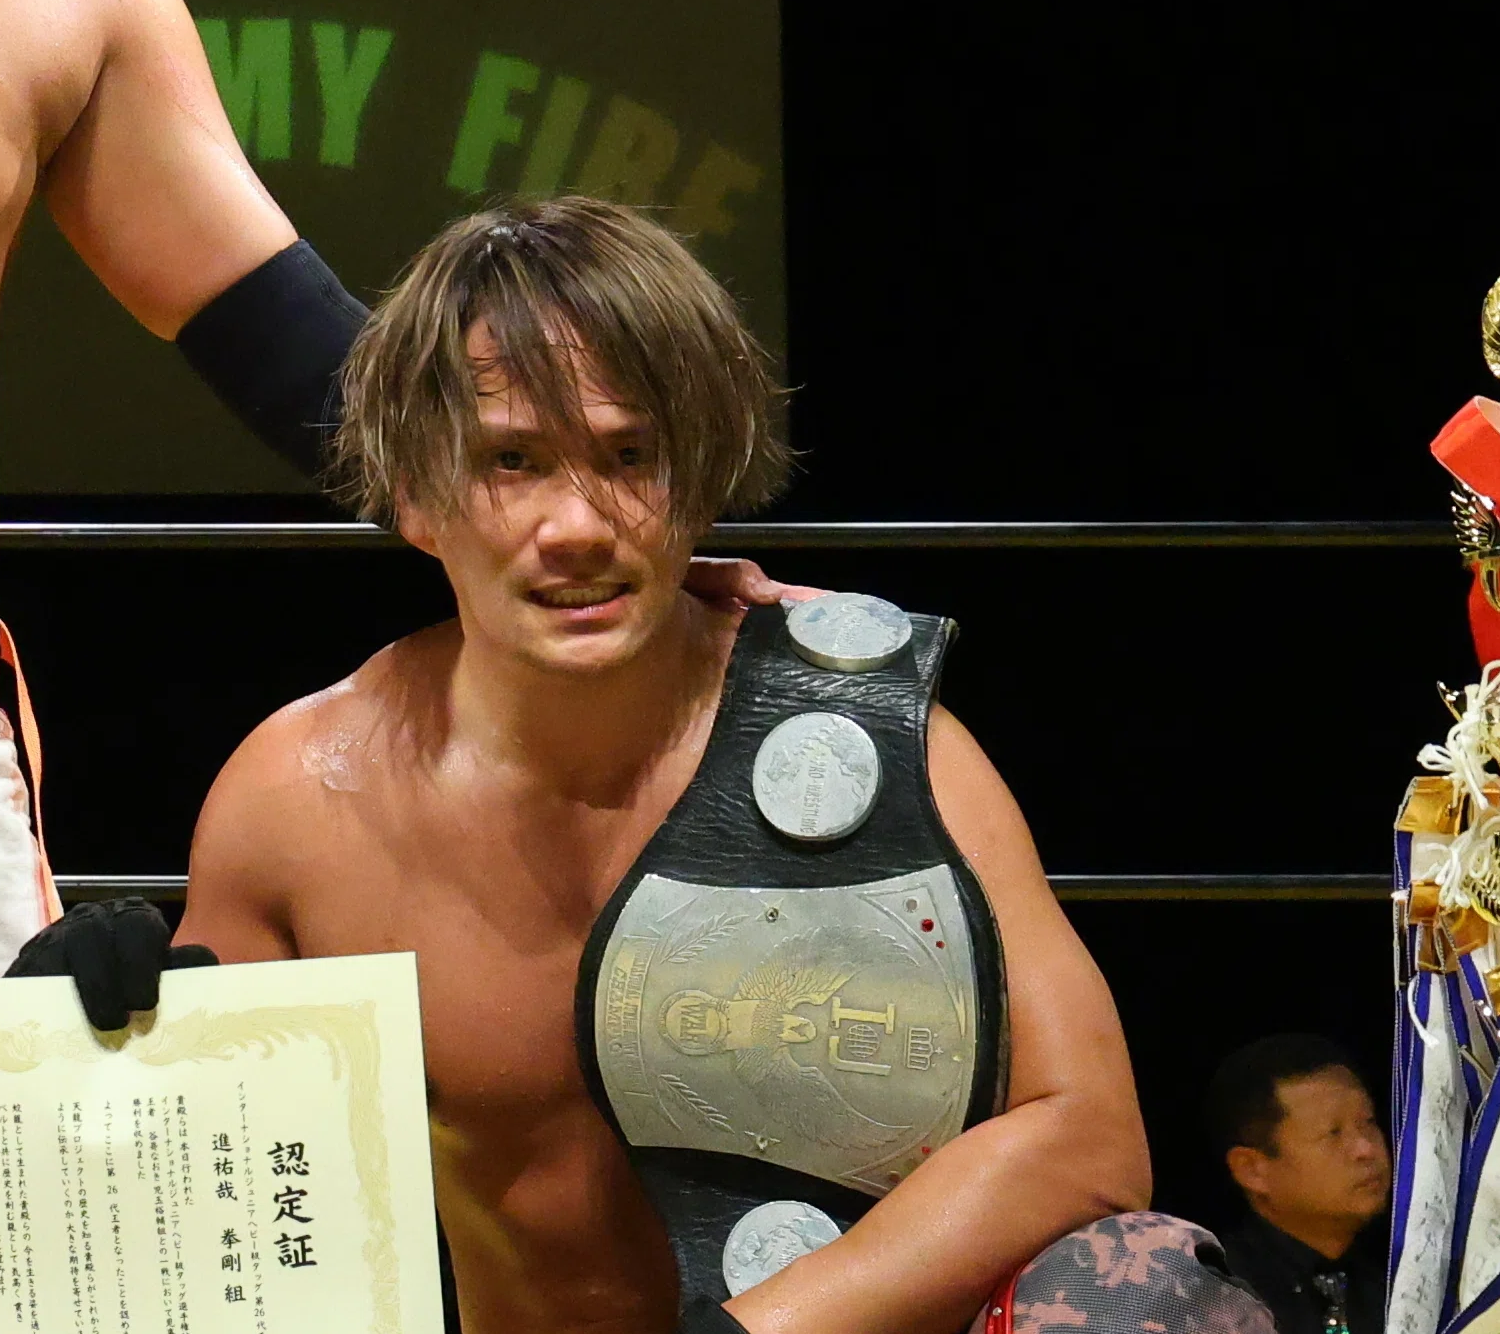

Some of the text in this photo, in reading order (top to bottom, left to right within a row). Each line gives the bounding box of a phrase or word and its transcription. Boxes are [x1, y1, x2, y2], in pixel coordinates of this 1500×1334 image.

[195, 17, 395, 169] MY
[212, 1133, 246, 1303] 進祐哉 拳剛 組
[268, 1142, 318, 1270] 認定証
